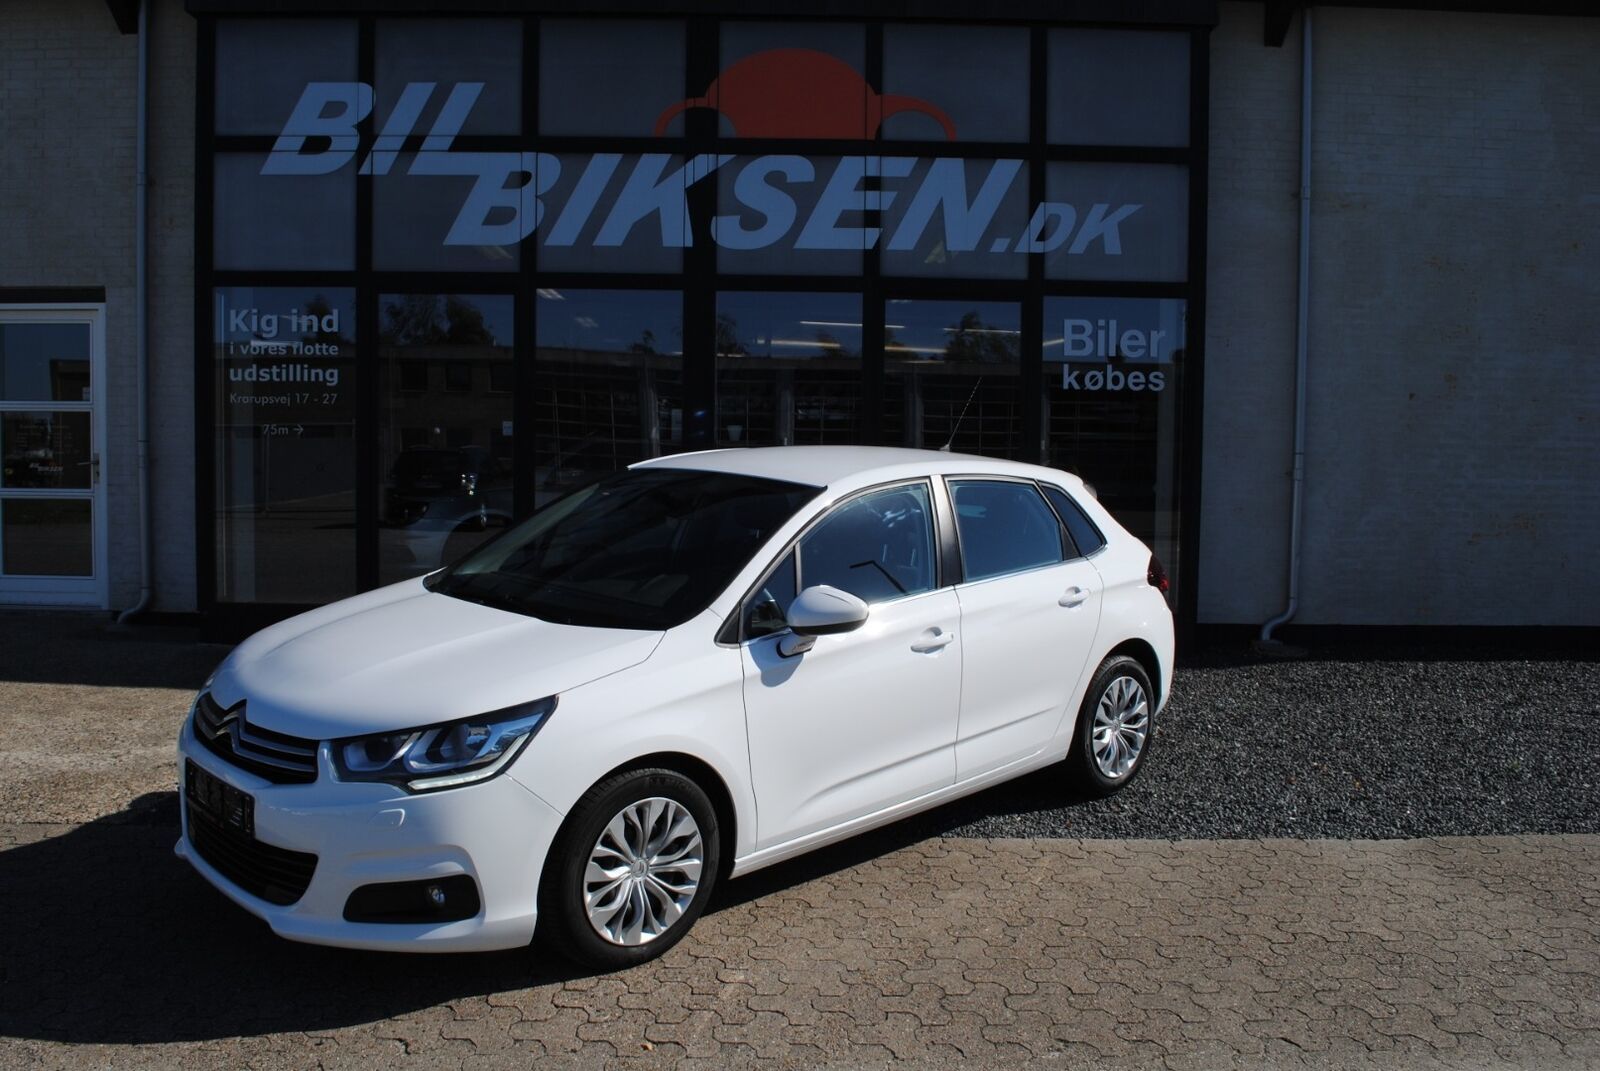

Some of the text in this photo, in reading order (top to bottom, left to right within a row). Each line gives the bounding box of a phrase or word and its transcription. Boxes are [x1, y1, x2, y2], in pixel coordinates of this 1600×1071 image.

[259, 81, 486, 176] BIL
[443, 152, 1144, 255] BIKSEN.DK
[229, 308, 339, 338] Kig ind
[230, 341, 339, 355] i vores flotte
[1063, 318, 1167, 358] Biler
[229, 363, 339, 386] udstilling
[1062, 363, 1166, 392] købes
[229, 392, 291, 407] Krarupsvej
[295, 393, 310, 405] 17
[322, 393, 338, 405] 27
[262, 424, 289, 436] 75m
